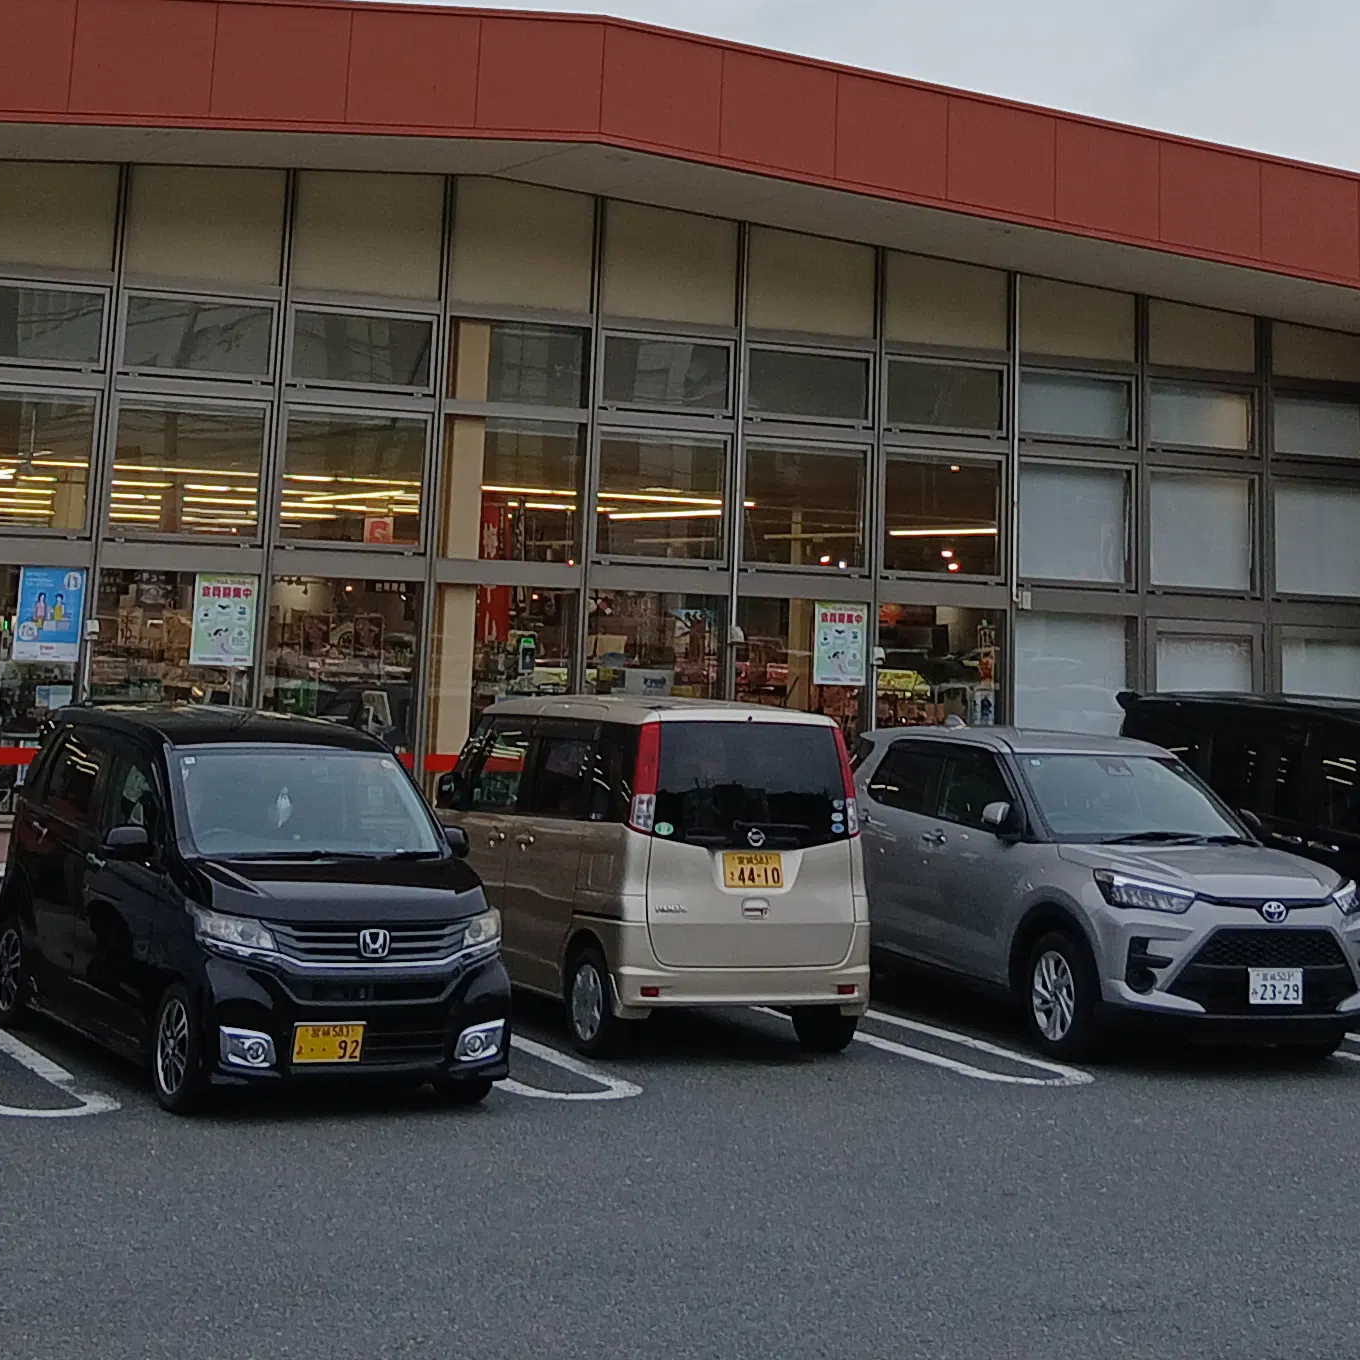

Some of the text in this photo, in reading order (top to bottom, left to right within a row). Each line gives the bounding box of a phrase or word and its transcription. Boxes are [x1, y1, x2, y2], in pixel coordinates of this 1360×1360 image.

[202, 585, 253, 600] 会員募集中
[737, 866, 781, 885] 44-10
[1260, 983, 1300, 1001] 23-29
[337, 1039, 360, 1060] 92
